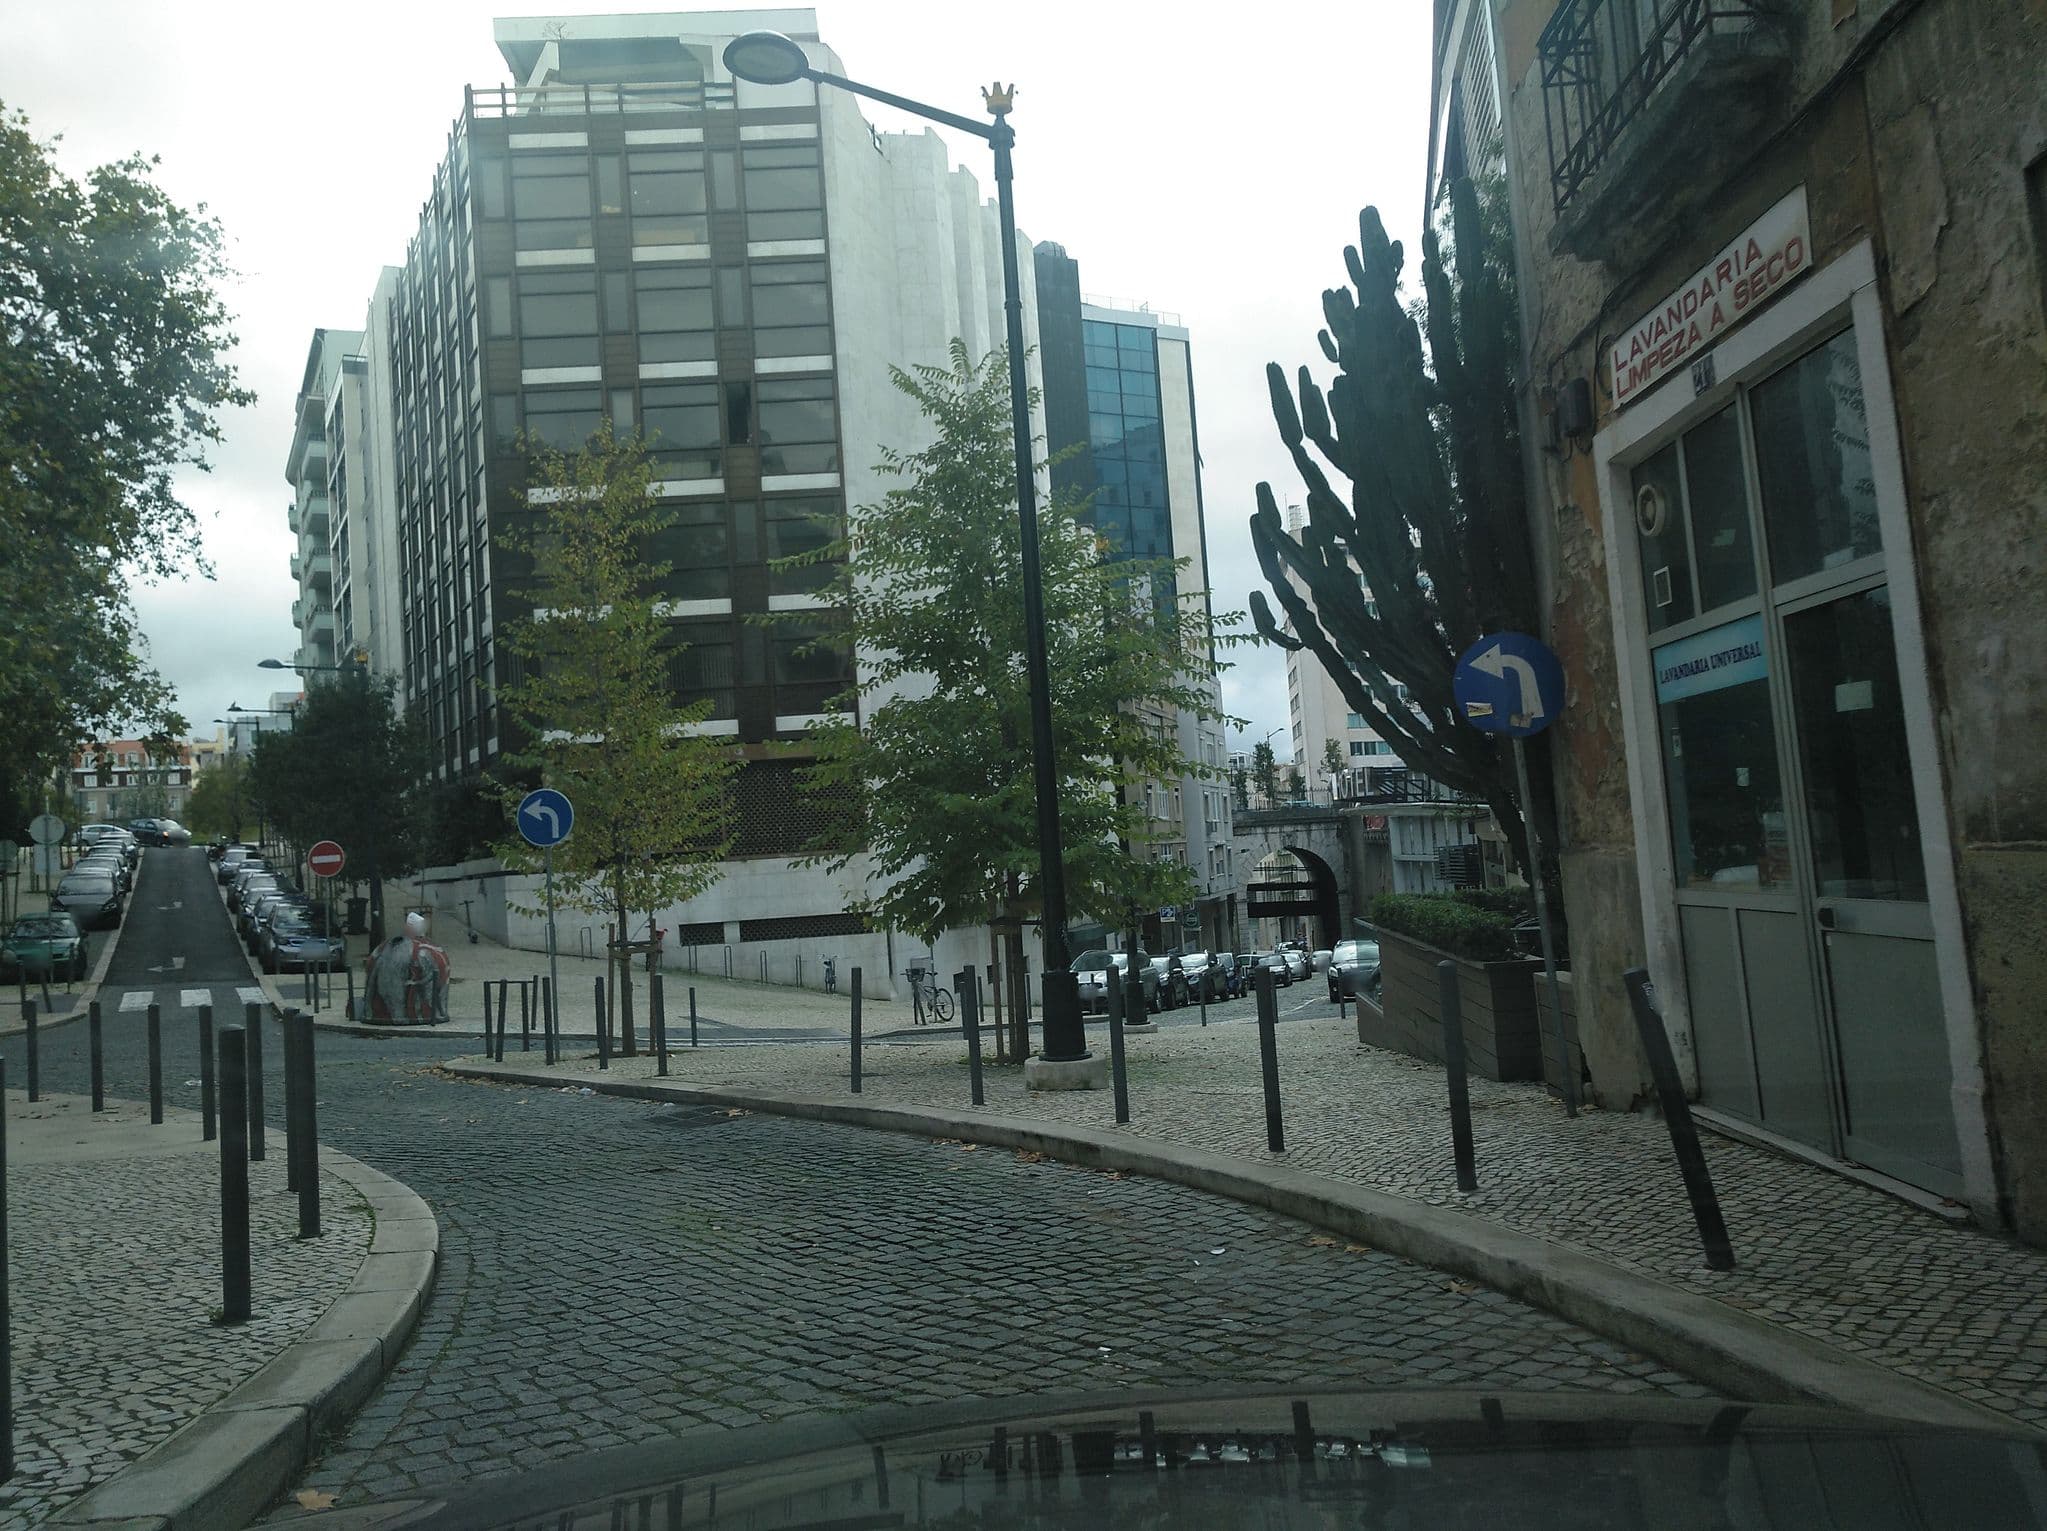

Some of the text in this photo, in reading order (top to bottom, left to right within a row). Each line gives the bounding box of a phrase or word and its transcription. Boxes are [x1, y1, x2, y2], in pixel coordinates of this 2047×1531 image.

[1614, 237, 1762, 372] LAVANDARIA
[1616, 321, 1701, 399] LIMPEZA
[1709, 302, 1725, 332] A
[1733, 236, 1803, 311] SECO
[1660, 641, 1762, 684] LAVANDARIA UNIVERSAL
